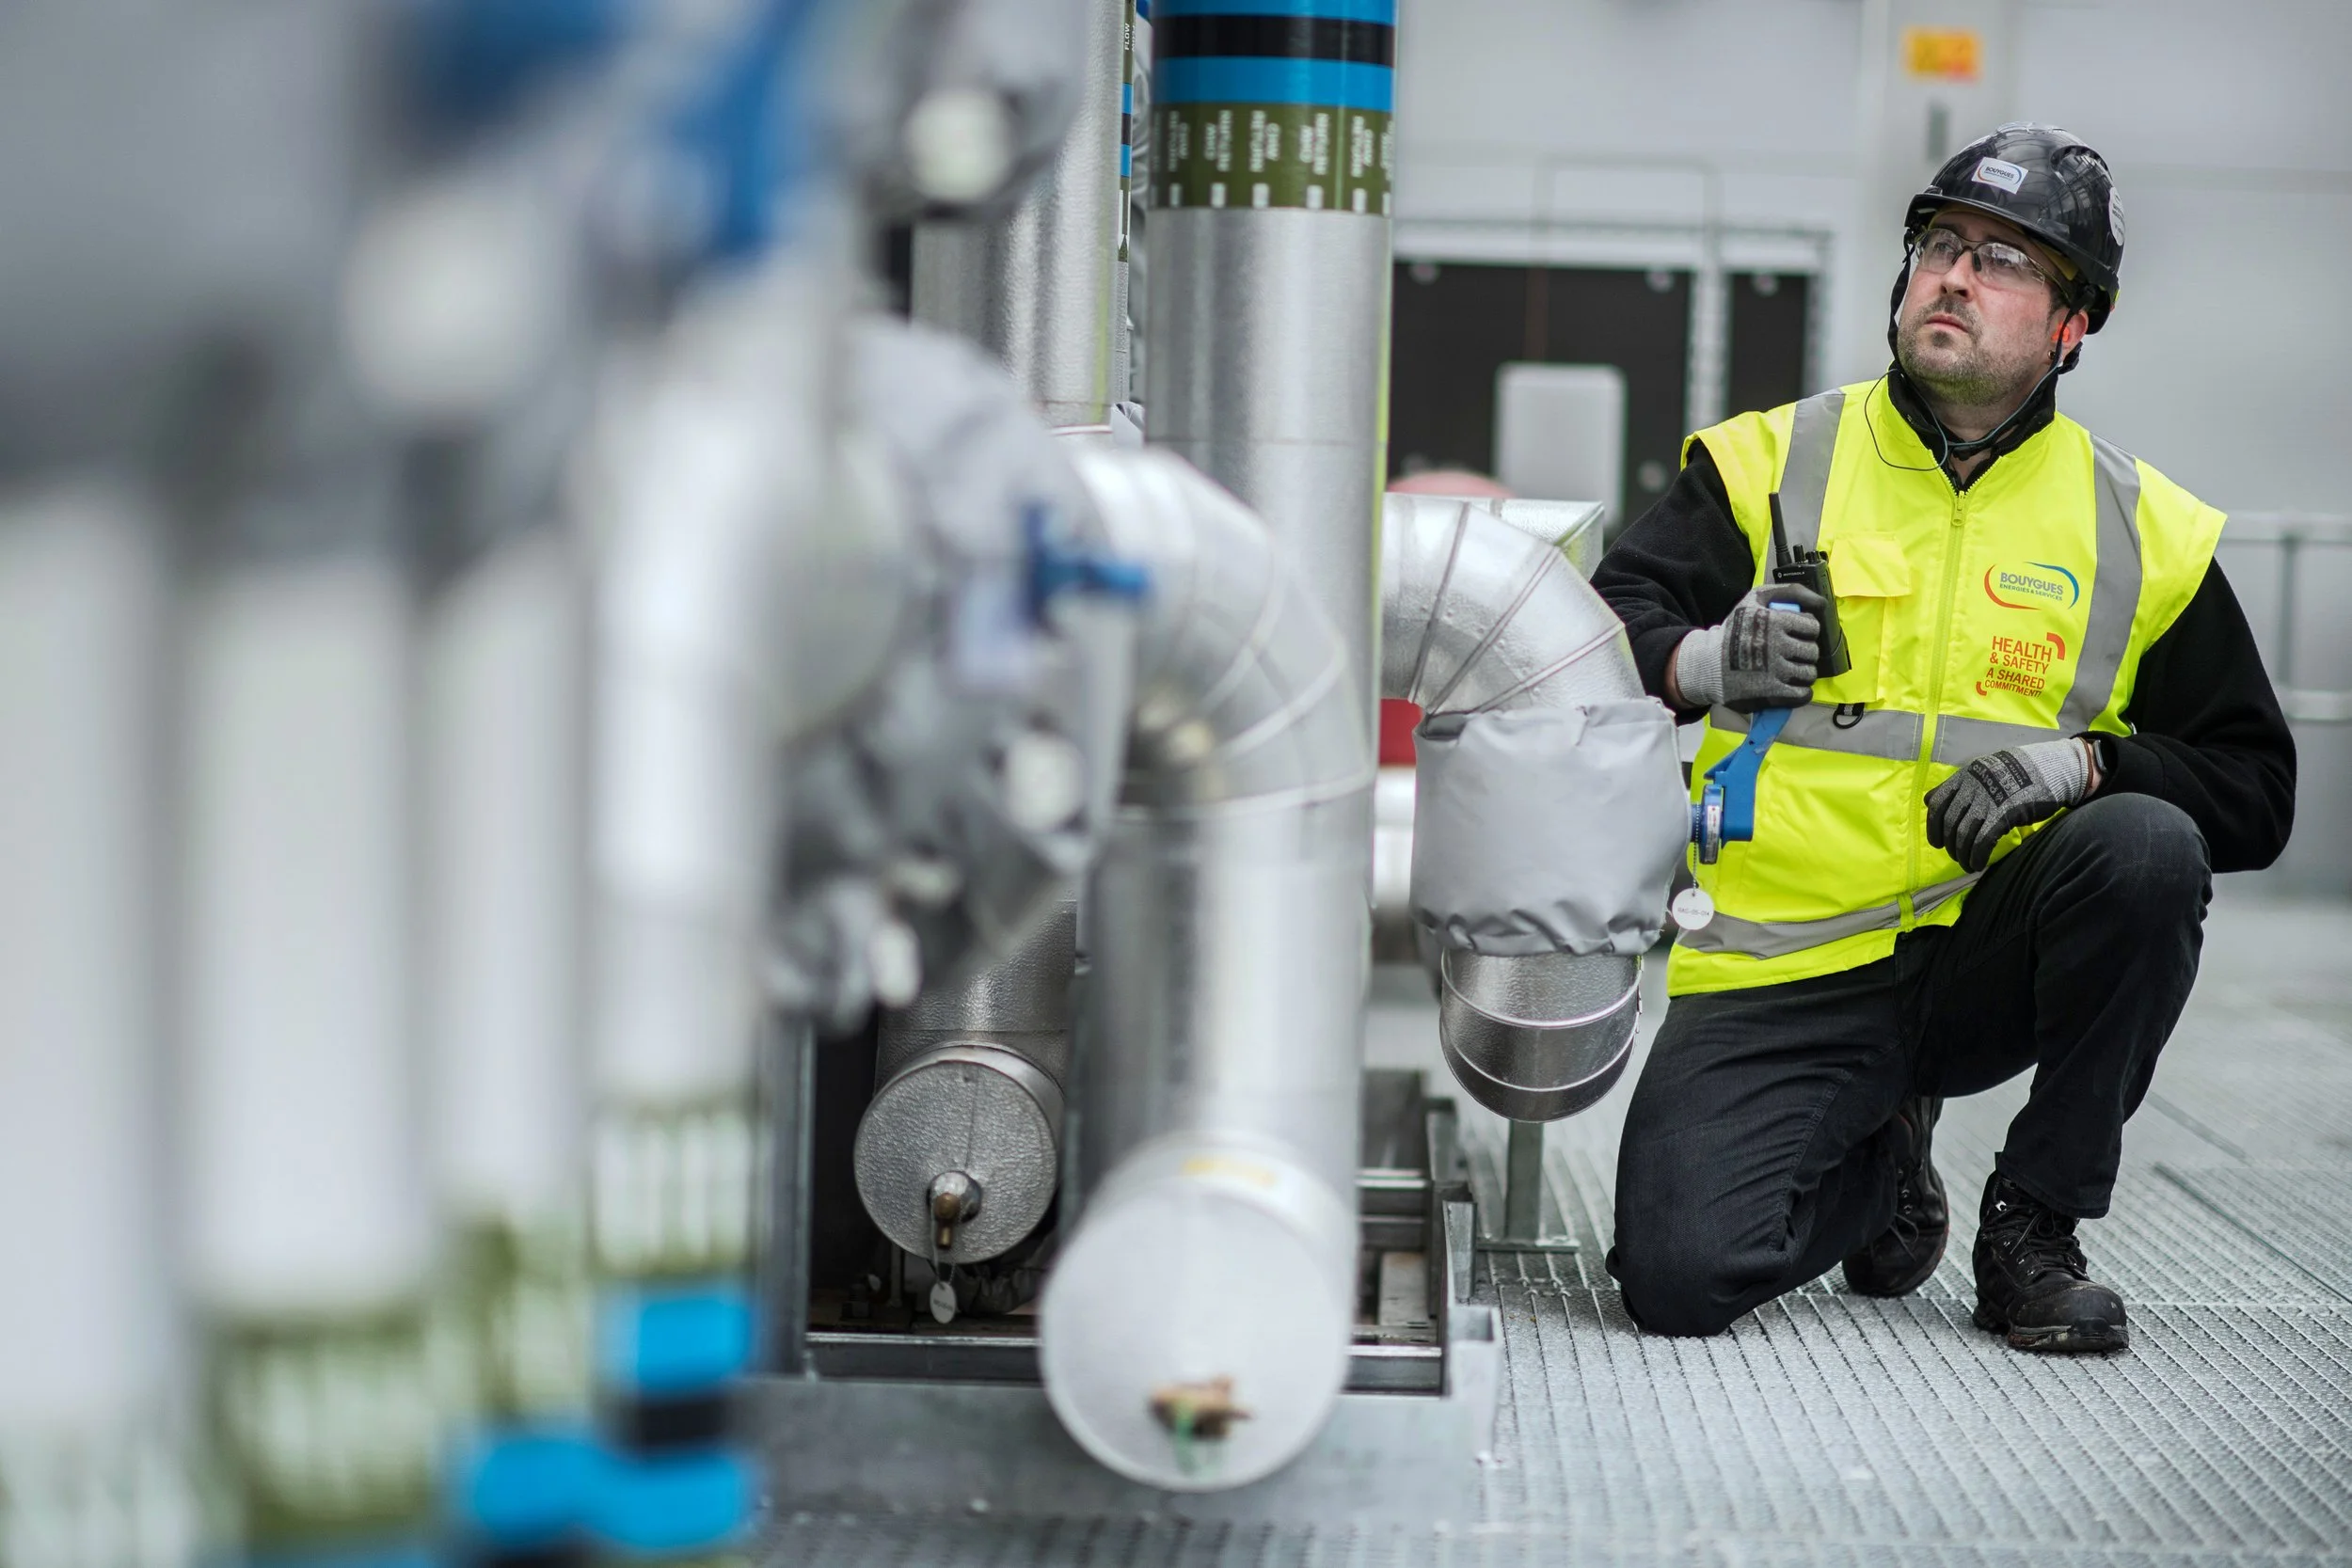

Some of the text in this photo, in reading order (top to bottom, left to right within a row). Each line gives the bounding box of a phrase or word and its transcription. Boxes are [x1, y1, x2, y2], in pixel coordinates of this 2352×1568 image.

[1249, 110, 1265, 172] RETURN
[1266, 123, 1279, 161] CHW
[1313, 113, 1328, 176] RETURN
[1985, 166, 2015, 179] BOUYGUES
[1999, 583, 2030, 594] ENERGIES
[2035, 590, 2062, 601] SERVICES
[2000, 572, 2063, 594] BOUYGUES
[1992, 636, 2052, 662] HEALTH
[1990, 652, 2049, 675] & SAFETY
[1984, 679, 2042, 697] COMMITMENT!
[1986, 667, 2045, 689] A SHARED
